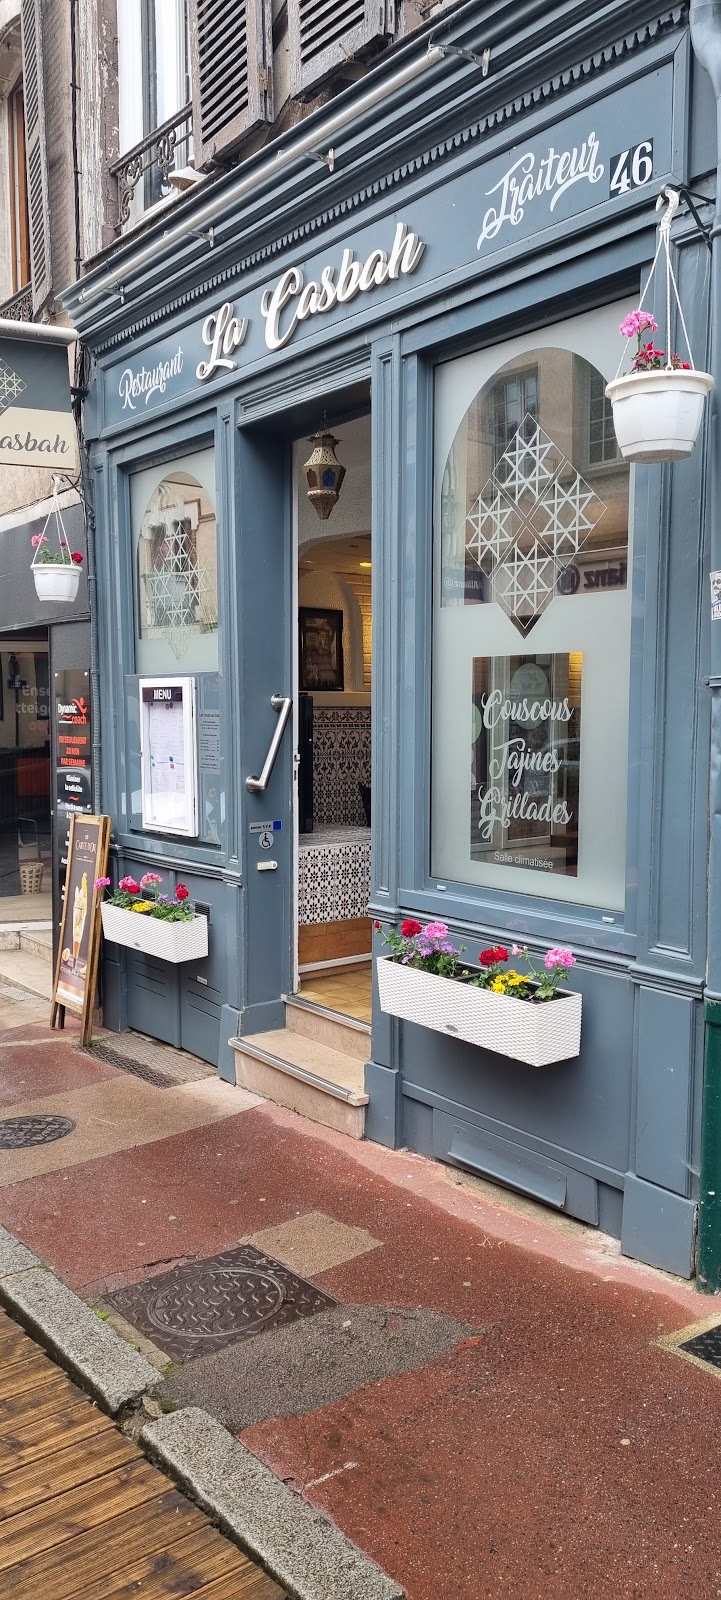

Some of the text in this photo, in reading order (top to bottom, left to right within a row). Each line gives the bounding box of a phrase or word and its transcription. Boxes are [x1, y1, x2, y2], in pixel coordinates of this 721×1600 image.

[477, 131, 604, 250] Traiteur
[610, 141, 653, 195] 46
[196, 222, 426, 379] La Casbah
[118, 346, 184, 409] Restaurant
[57, 703, 78, 716] Dynamic
[153, 689, 172, 700] MENU
[481, 689, 575, 729] Couscous
[71, 714, 87, 725] coach
[489, 738, 563, 788] Tajines
[478, 785, 573, 839] Grillades
[76, 839, 87, 851] CARTE
[494, 851, 554, 869] Salle climatisée
